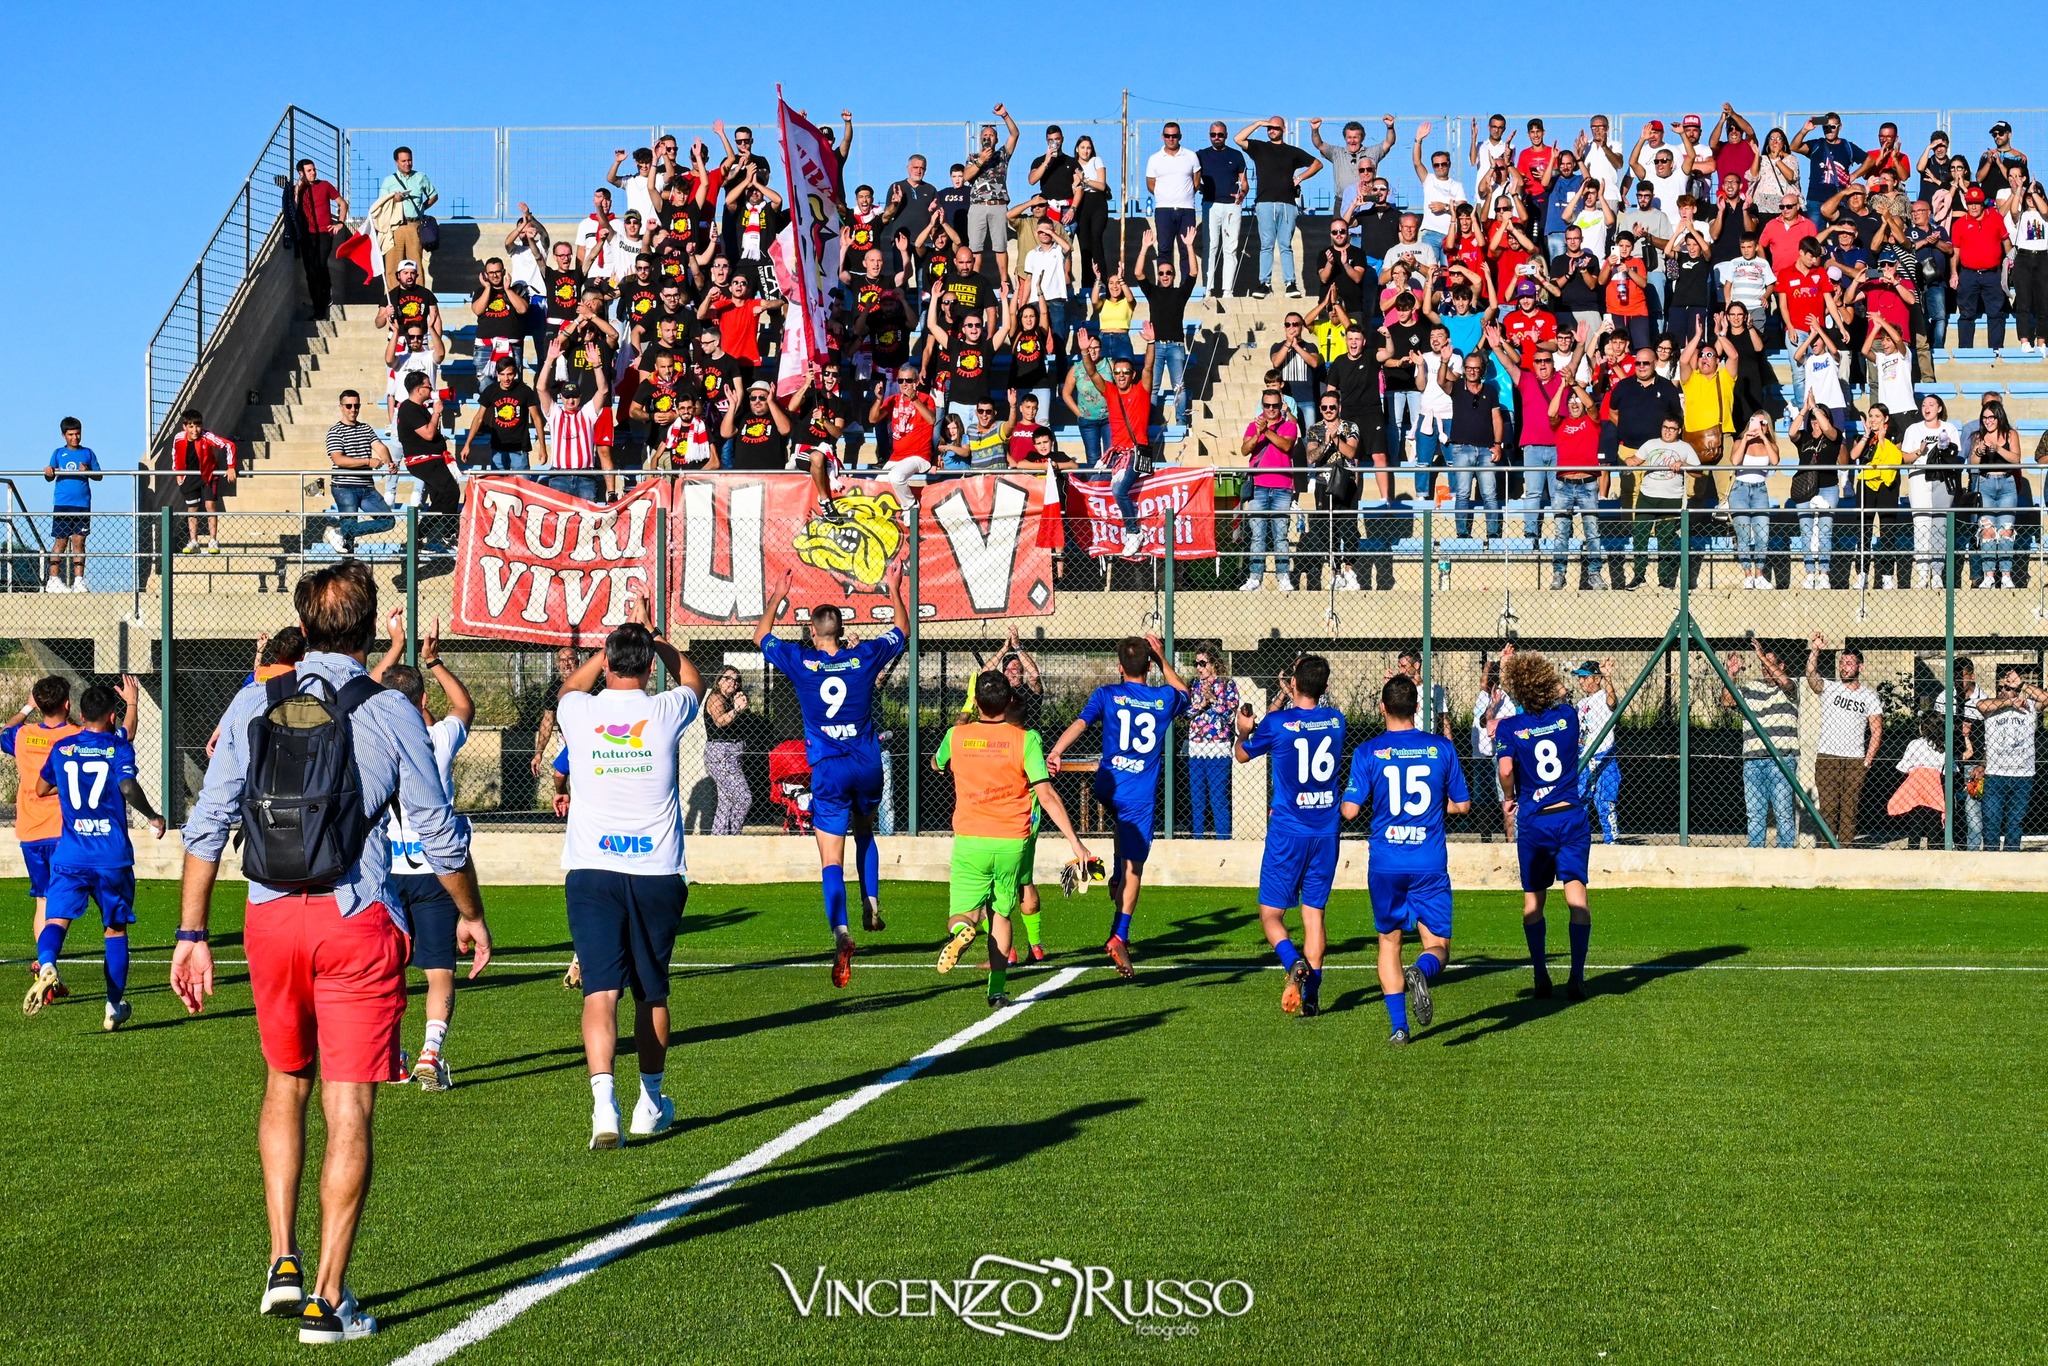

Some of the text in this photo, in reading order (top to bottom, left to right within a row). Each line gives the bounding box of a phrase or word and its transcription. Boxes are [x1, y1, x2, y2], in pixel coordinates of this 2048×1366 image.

[483, 490, 653, 562] TURI
[479, 555, 648, 626] VIVE
[820, 676, 847, 719] 9
[1833, 695, 1865, 713] GUESS
[1117, 709, 1156, 753] 13
[1294, 736, 1334, 783] 16
[1534, 740, 1562, 781] 8
[63, 761, 109, 810] 17
[1296, 791, 1333, 806] AVIS
[1383, 765, 1431, 816] 15
[74, 819, 111, 832] AVIS
[598, 835, 653, 853] AVIS
[1385, 826, 1426, 841] AVIS
